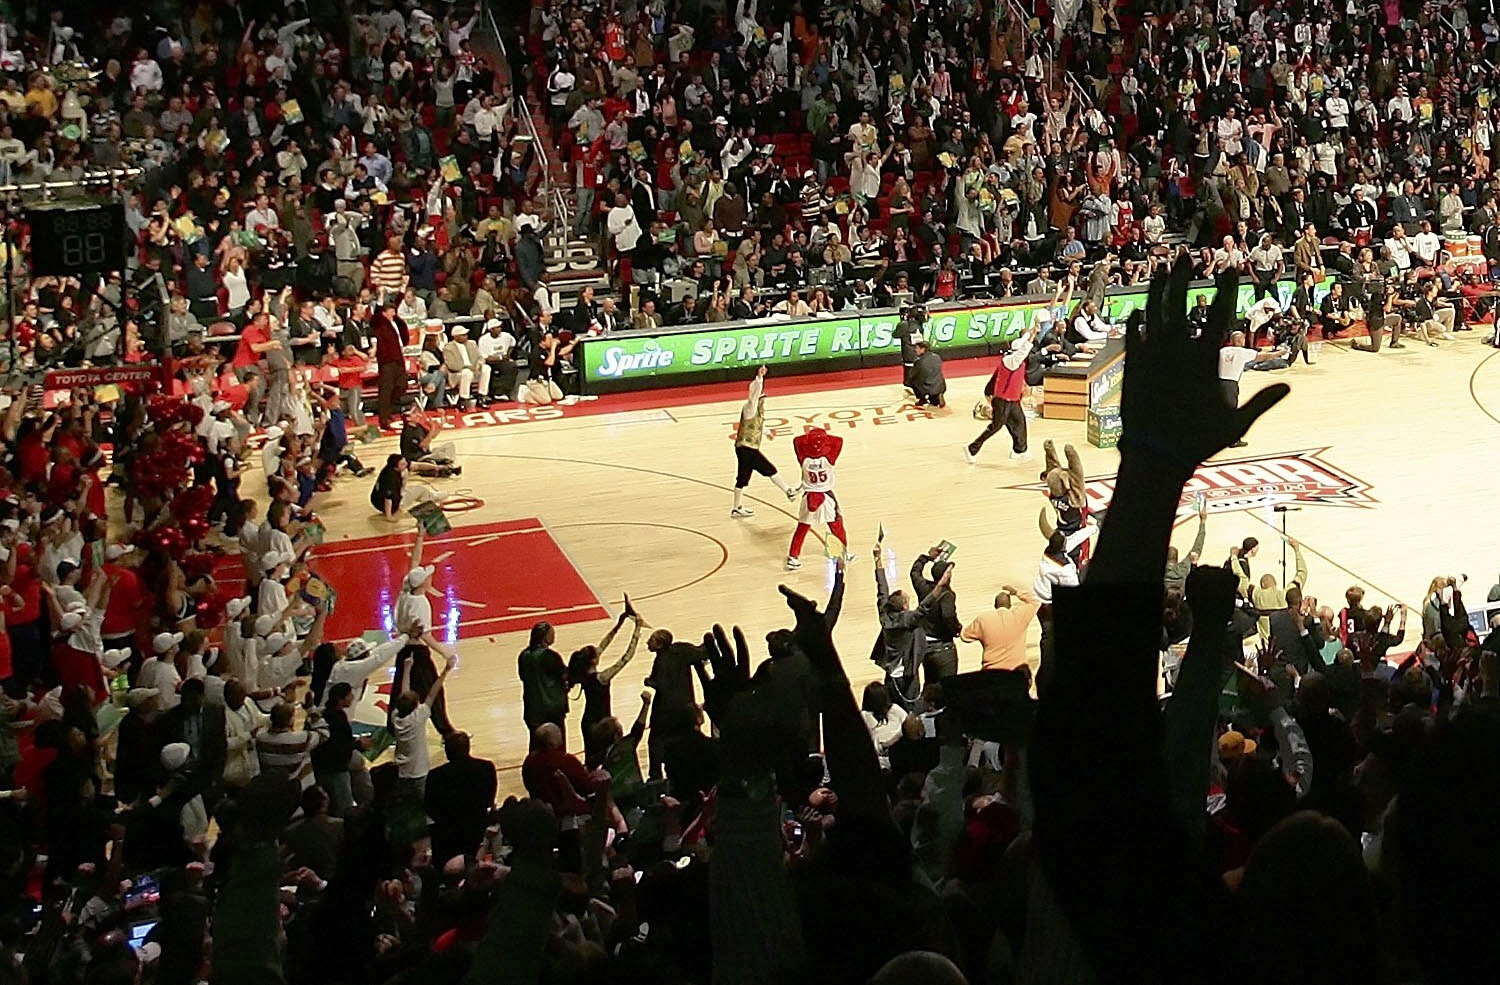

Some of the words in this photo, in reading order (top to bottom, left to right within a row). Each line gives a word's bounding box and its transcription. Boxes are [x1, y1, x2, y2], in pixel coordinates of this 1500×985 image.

[597, 345, 675, 377] Sprite
[690, 327, 822, 366] SPRITE
[55, 373, 101, 385] TOYOTA
[104, 370, 152, 383] CENTER
